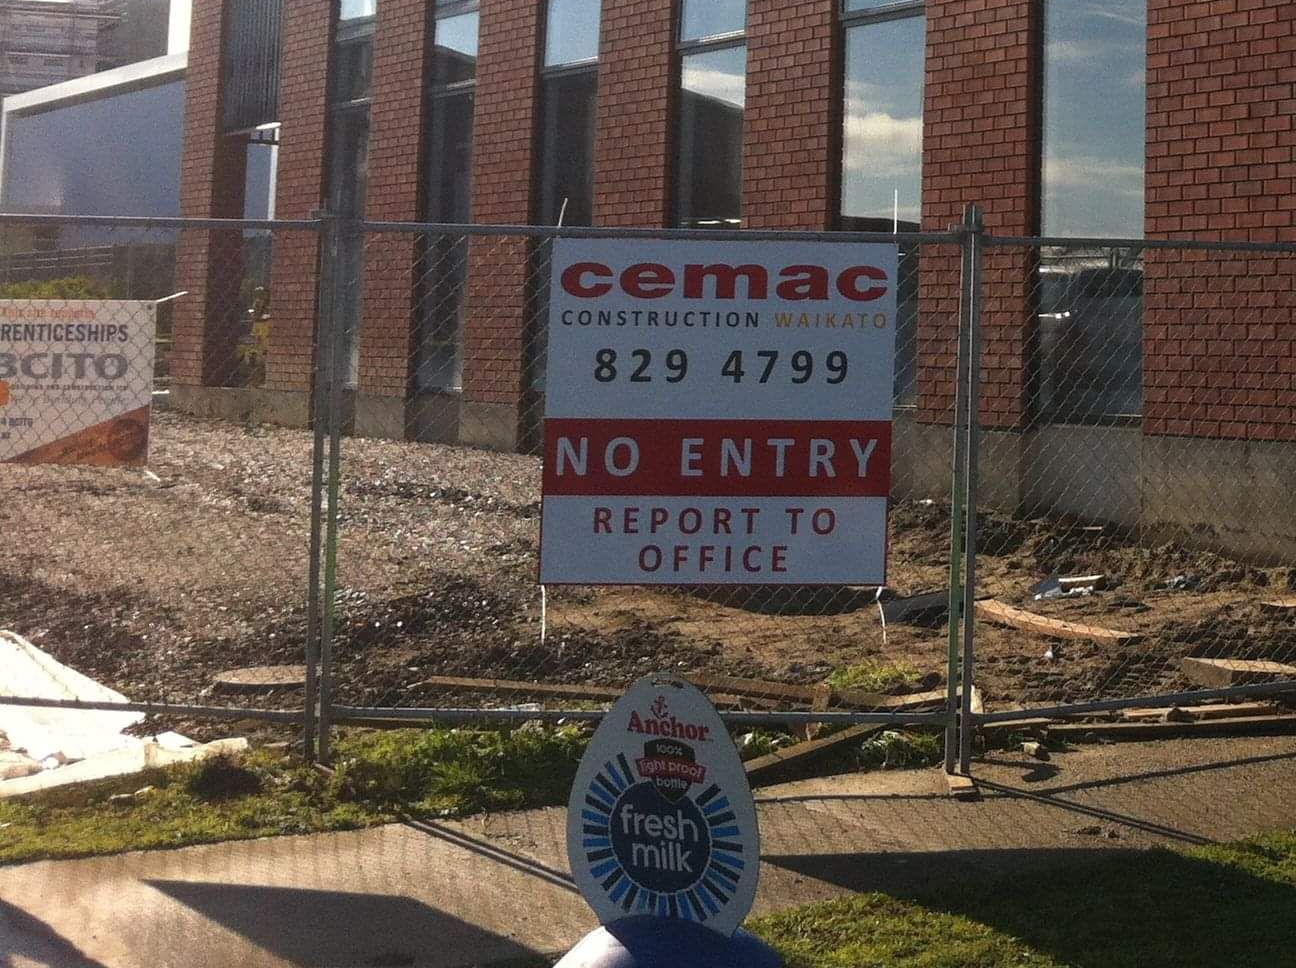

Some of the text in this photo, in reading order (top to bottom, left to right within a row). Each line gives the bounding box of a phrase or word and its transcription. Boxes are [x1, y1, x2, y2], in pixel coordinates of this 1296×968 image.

[560, 262, 889, 302] cemac
[561, 309, 888, 329] CONSTRUCTION WAIKATO
[593, 348, 849, 385] 829 4799
[555, 436, 879, 478] NO ENTRY
[593, 507, 836, 535] REPORT TO
[638, 545, 788, 573] OFFICE
[627, 710, 710, 742] Anchor
[620, 803, 699, 843] fresh
[631, 842, 693, 873] milk
